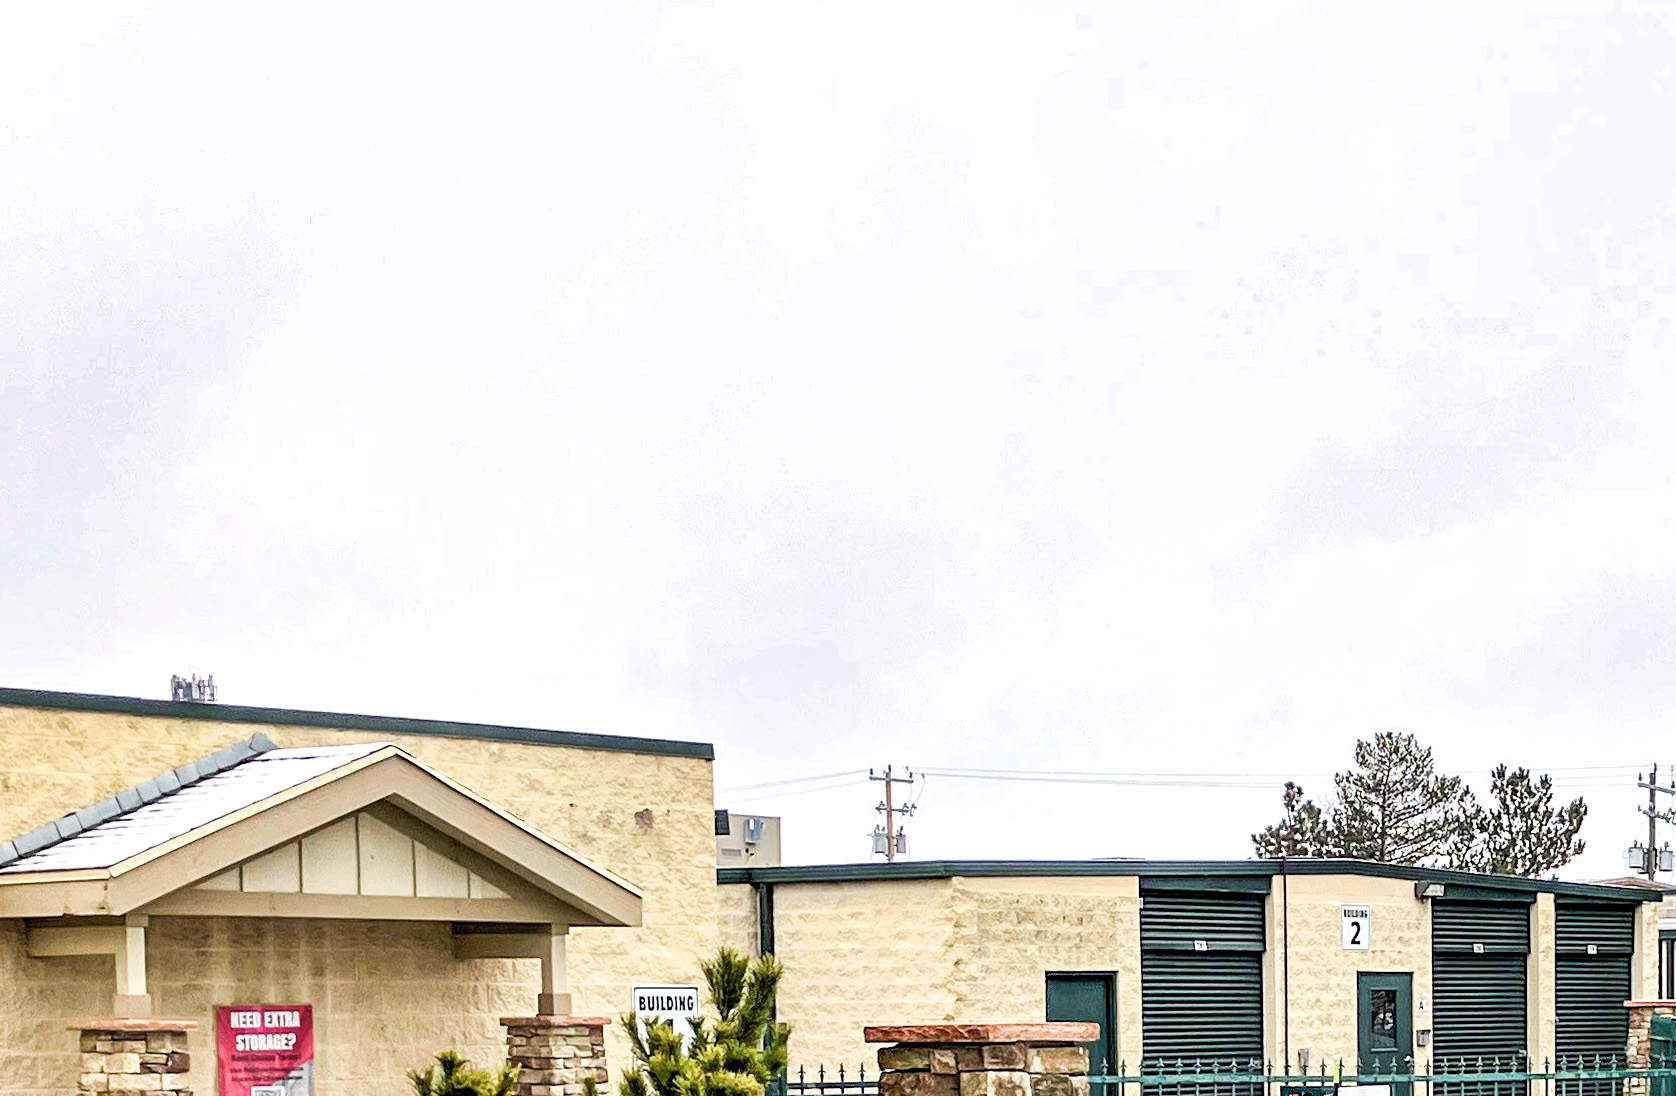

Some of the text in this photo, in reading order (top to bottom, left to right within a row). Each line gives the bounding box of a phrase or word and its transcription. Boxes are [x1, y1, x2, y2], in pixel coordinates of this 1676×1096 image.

[1350, 921, 1361, 945] 2
[639, 996, 694, 1011] BUILDING
[1418, 1001, 1424, 1010] A
[230, 1011, 300, 1028] NEED EXTRA
[236, 1033, 297, 1051] STORAGE?
